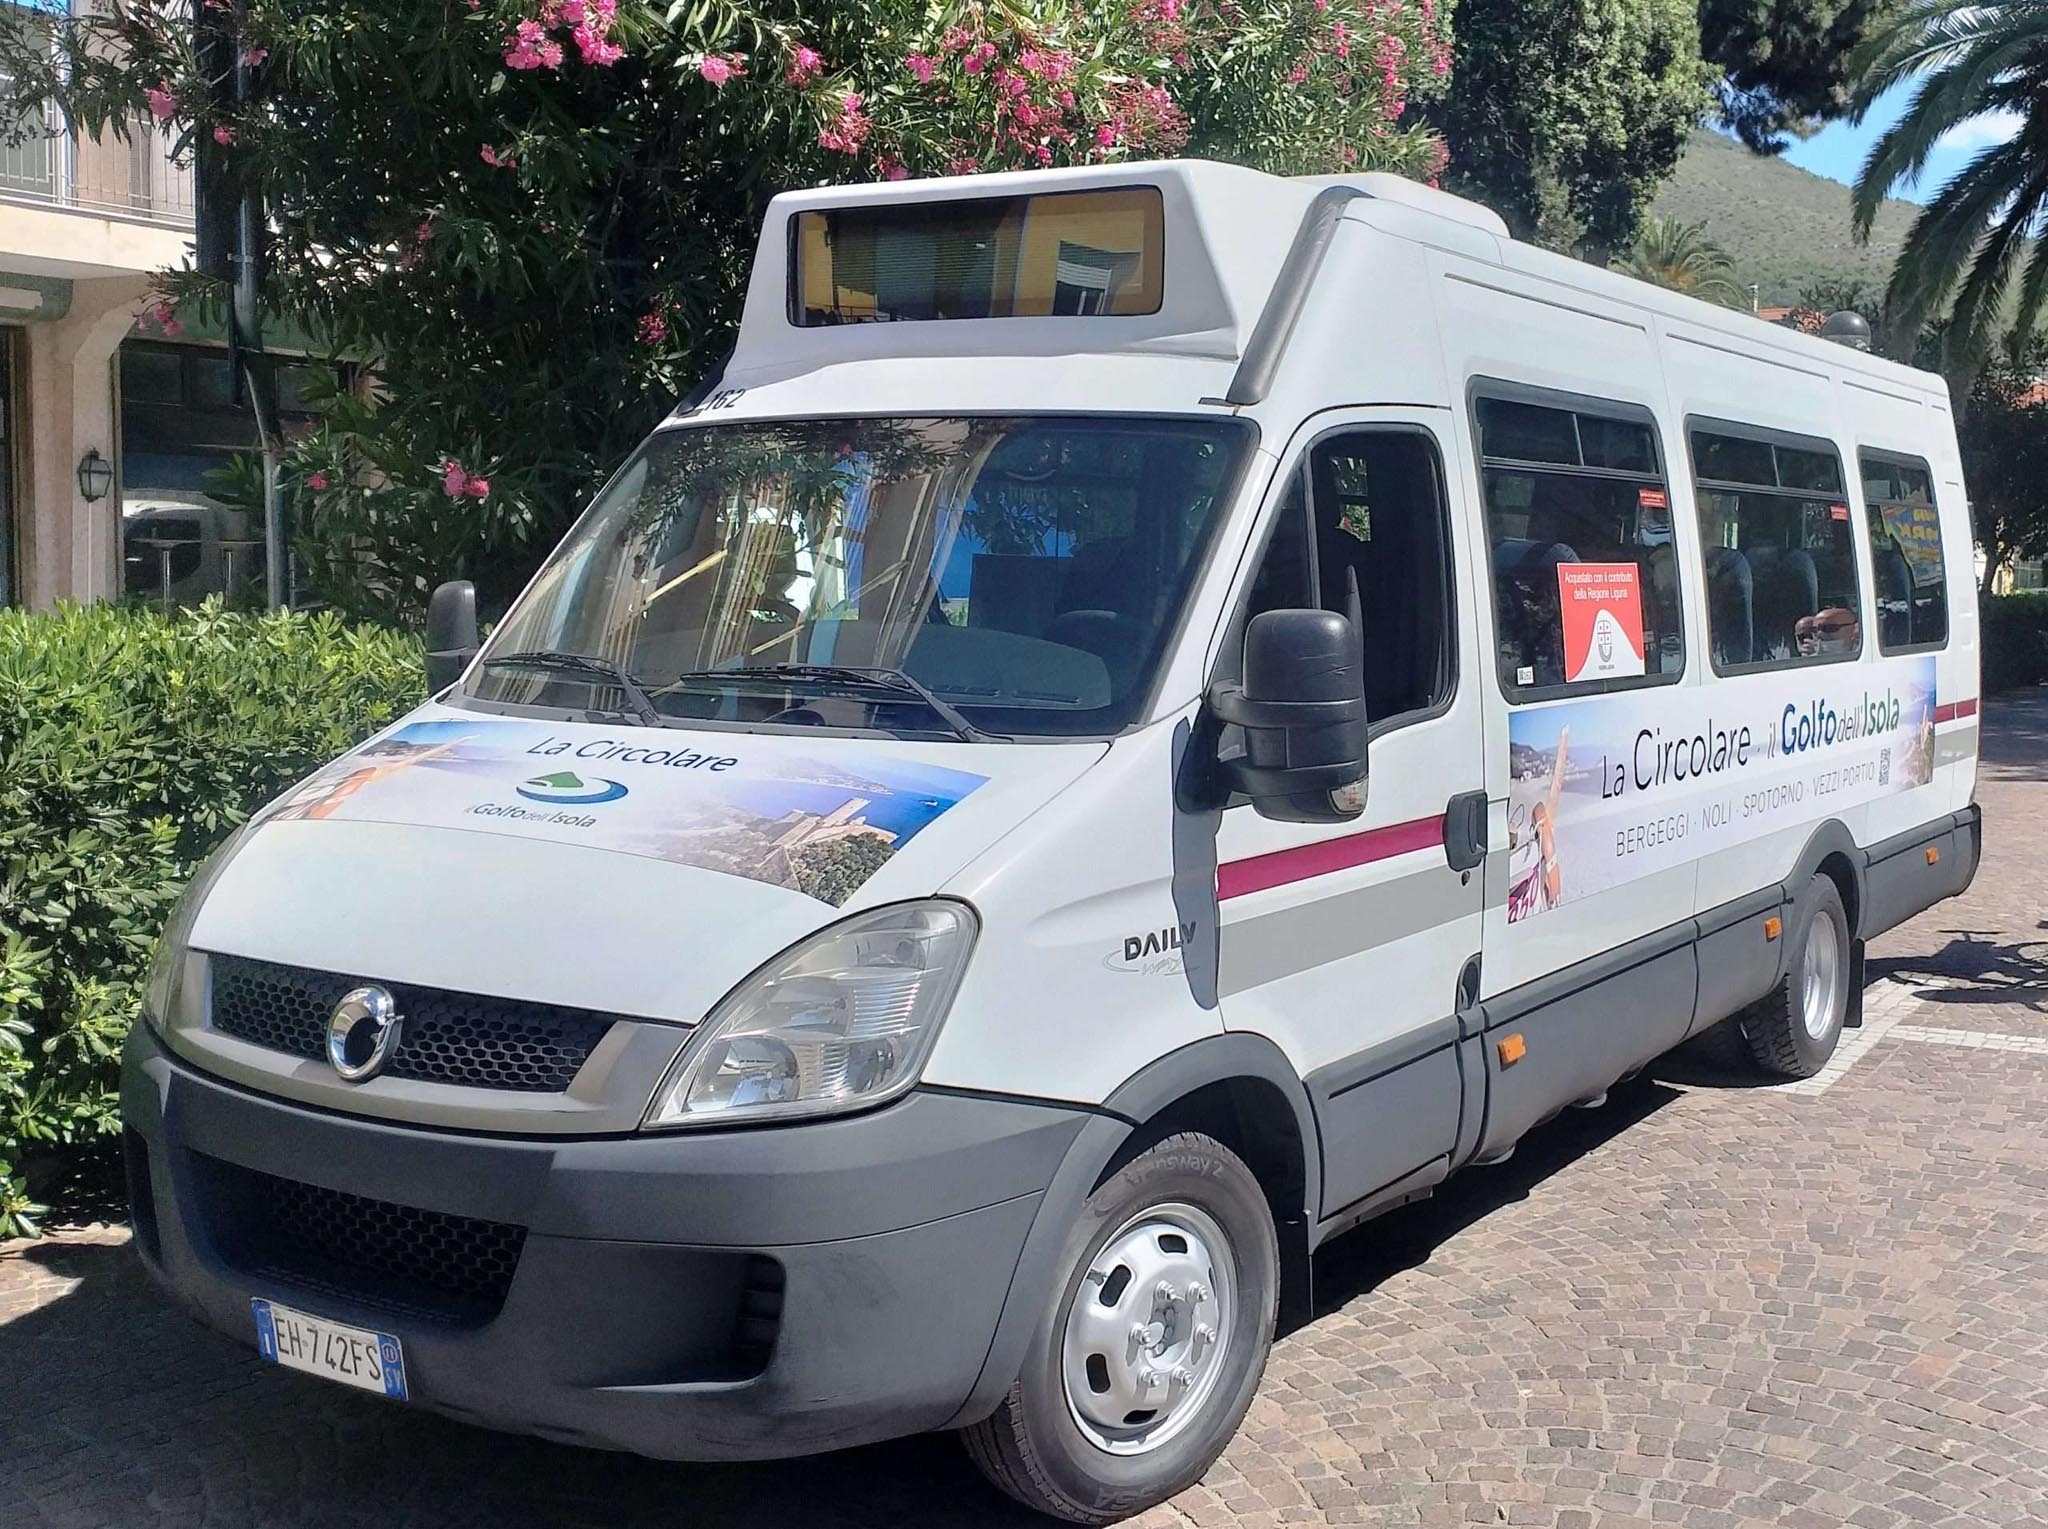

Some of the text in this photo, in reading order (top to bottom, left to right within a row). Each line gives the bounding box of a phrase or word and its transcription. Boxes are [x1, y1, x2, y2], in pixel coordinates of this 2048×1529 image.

[525, 736, 739, 772] La Circolare
[1601, 755, 1625, 799] La
[1633, 719, 1751, 791] Circolare
[1767, 722, 1777, 760] il
[1616, 761, 1875, 857] BERGEGGI NOLI SPOTORNO VEZZI PORTIO
[1124, 921, 1197, 962] DAILY
